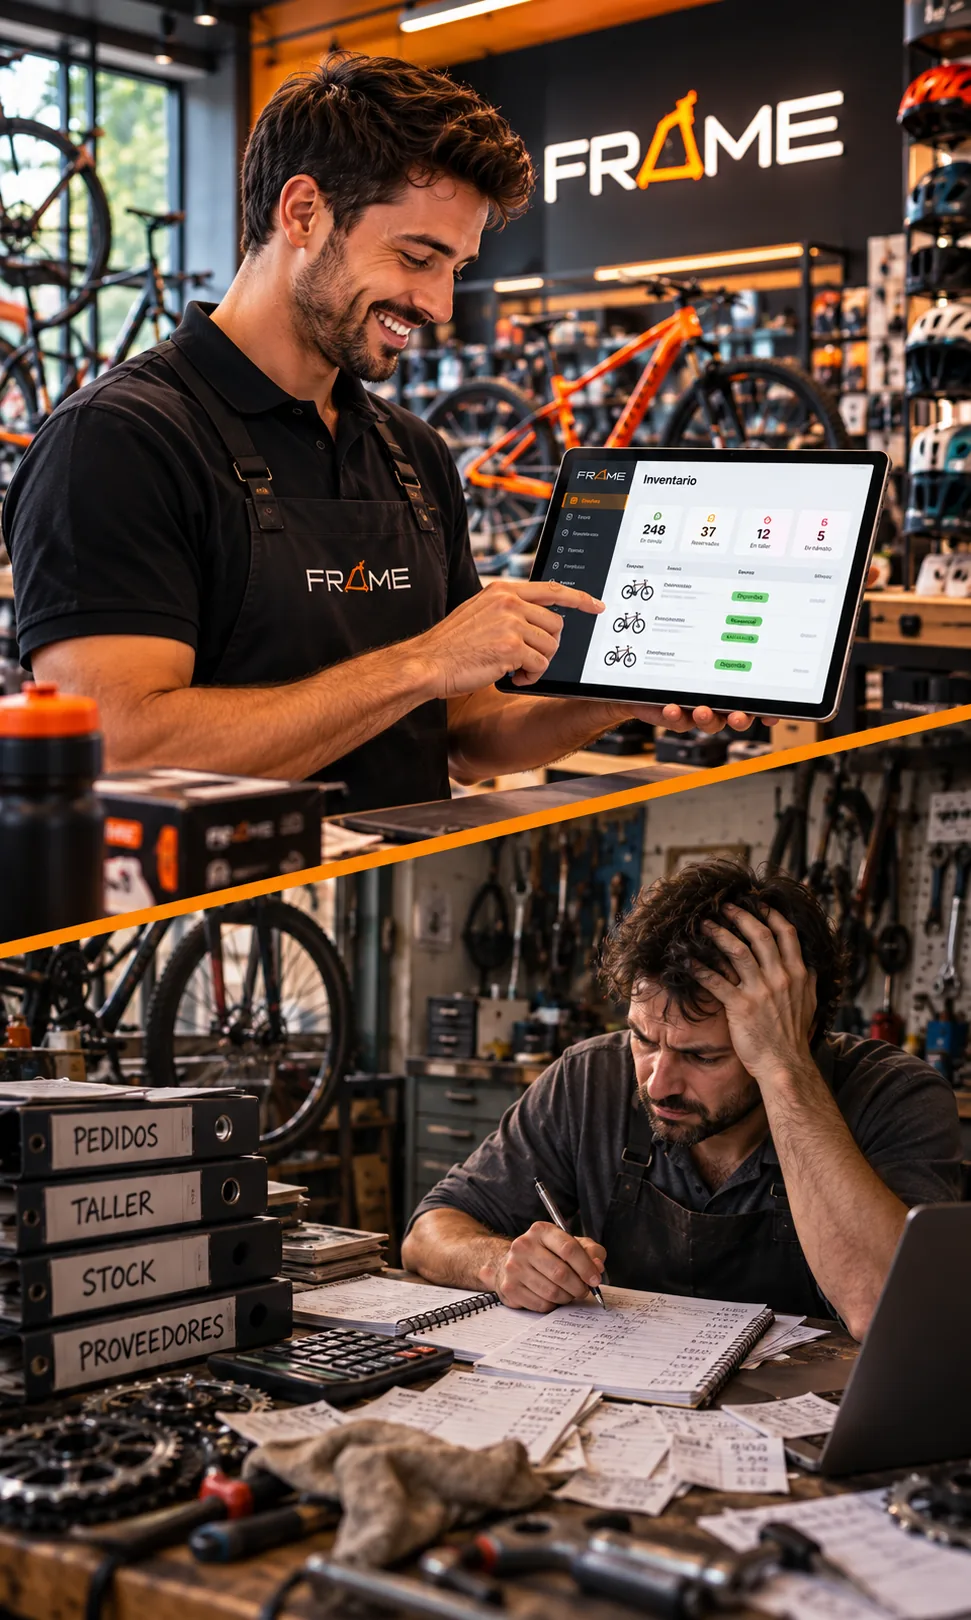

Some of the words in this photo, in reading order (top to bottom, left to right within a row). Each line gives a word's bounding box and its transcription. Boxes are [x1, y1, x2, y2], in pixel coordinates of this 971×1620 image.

[544, 88, 845, 204] FRAME
[576, 469, 627, 482] FRAME
[643, 474, 697, 487] Inventario
[642, 524, 666, 536] 248
[700, 526, 717, 538] 37
[757, 528, 771, 540] 12
[817, 530, 825, 542] 5
[305, 559, 411, 593] FRAME
[73, 1123, 159, 1155] PEDIDOS
[71, 1190, 154, 1225] TALLER
[82, 1258, 156, 1297] STOCK
[79, 1313, 224, 1372] PROVEEDORES
